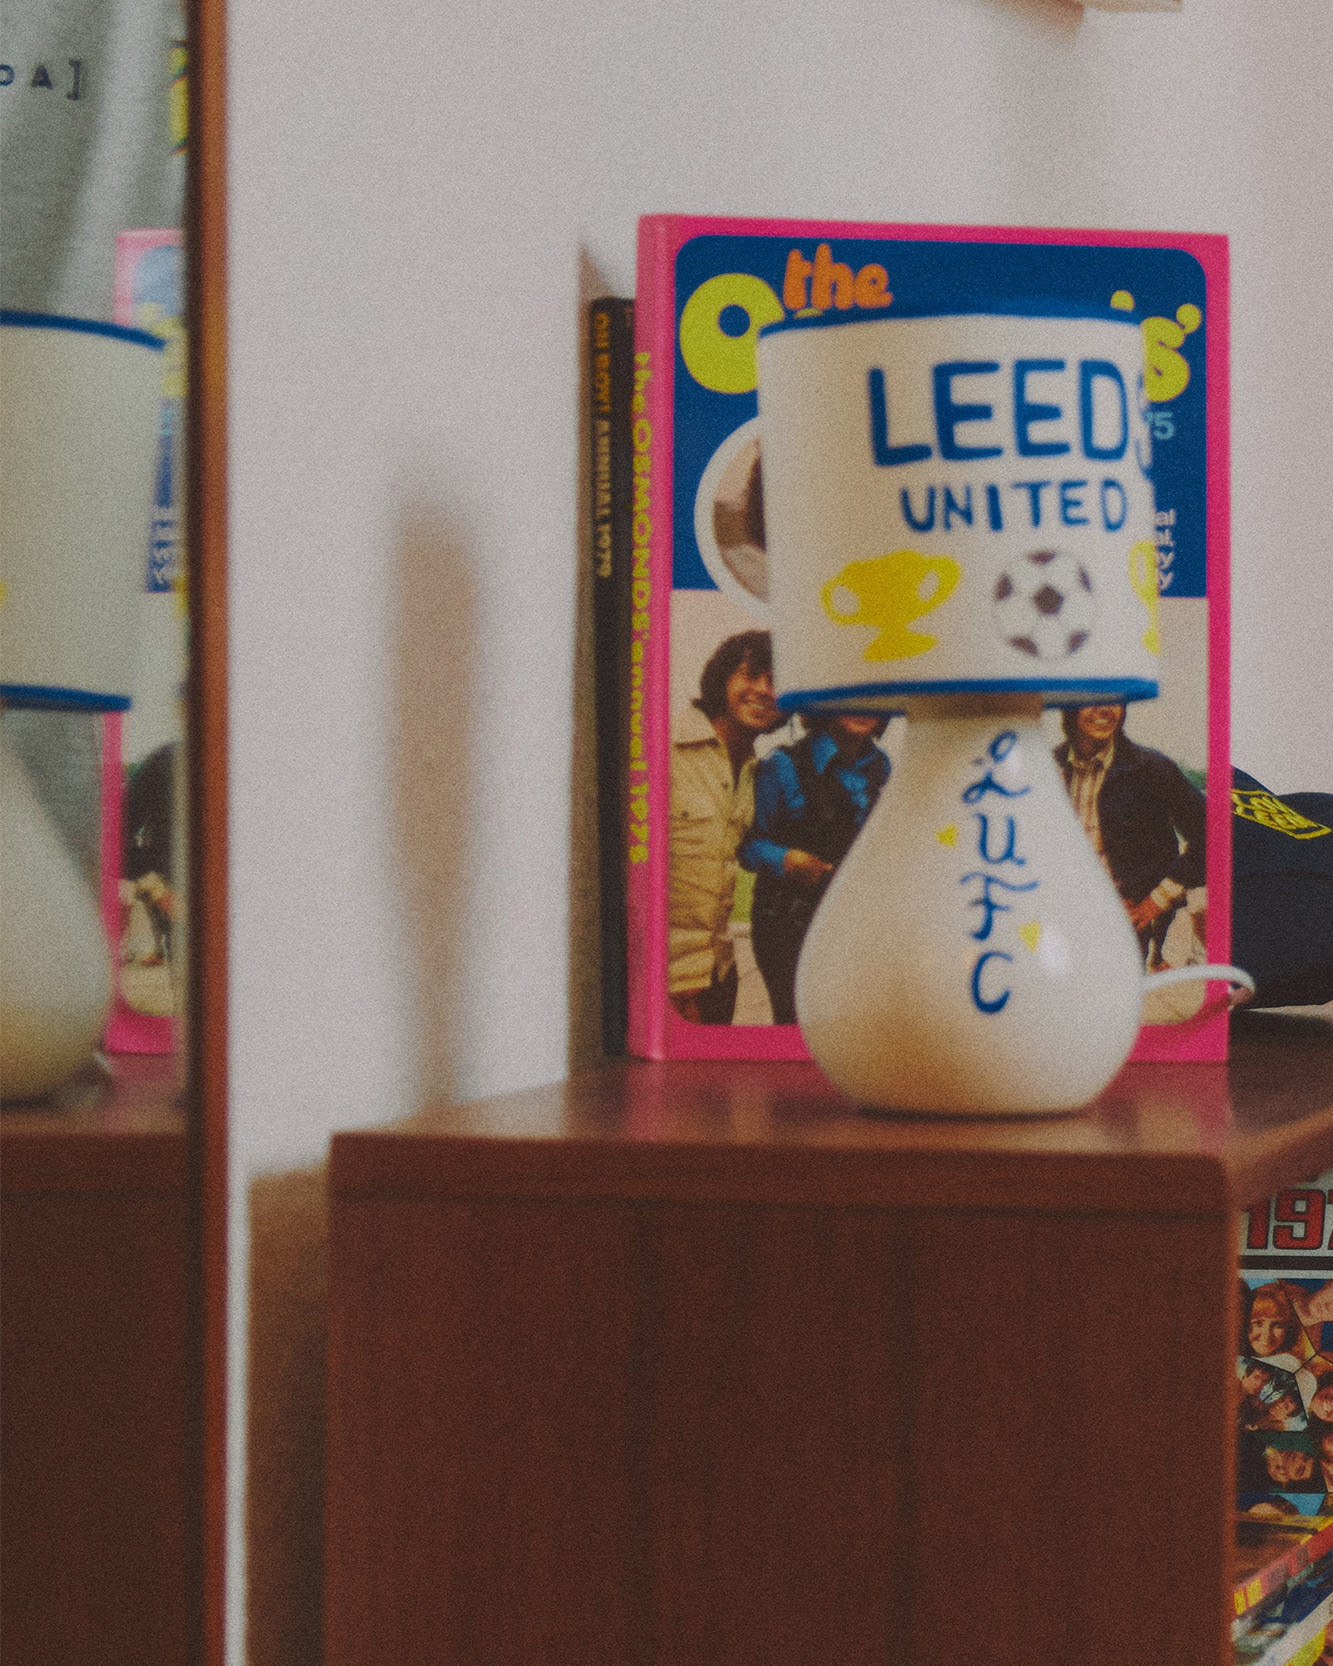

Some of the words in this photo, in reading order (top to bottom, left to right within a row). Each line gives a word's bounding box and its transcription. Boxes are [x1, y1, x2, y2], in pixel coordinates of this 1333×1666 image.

[782, 243, 894, 310] the
[594, 311, 609, 349] OH
[633, 351, 652, 415] the
[595, 419, 612, 517] ANNUAL
[901, 477, 1128, 534] UNITED
[630, 639, 649, 771] annual
[628, 780, 650, 865] 1975
